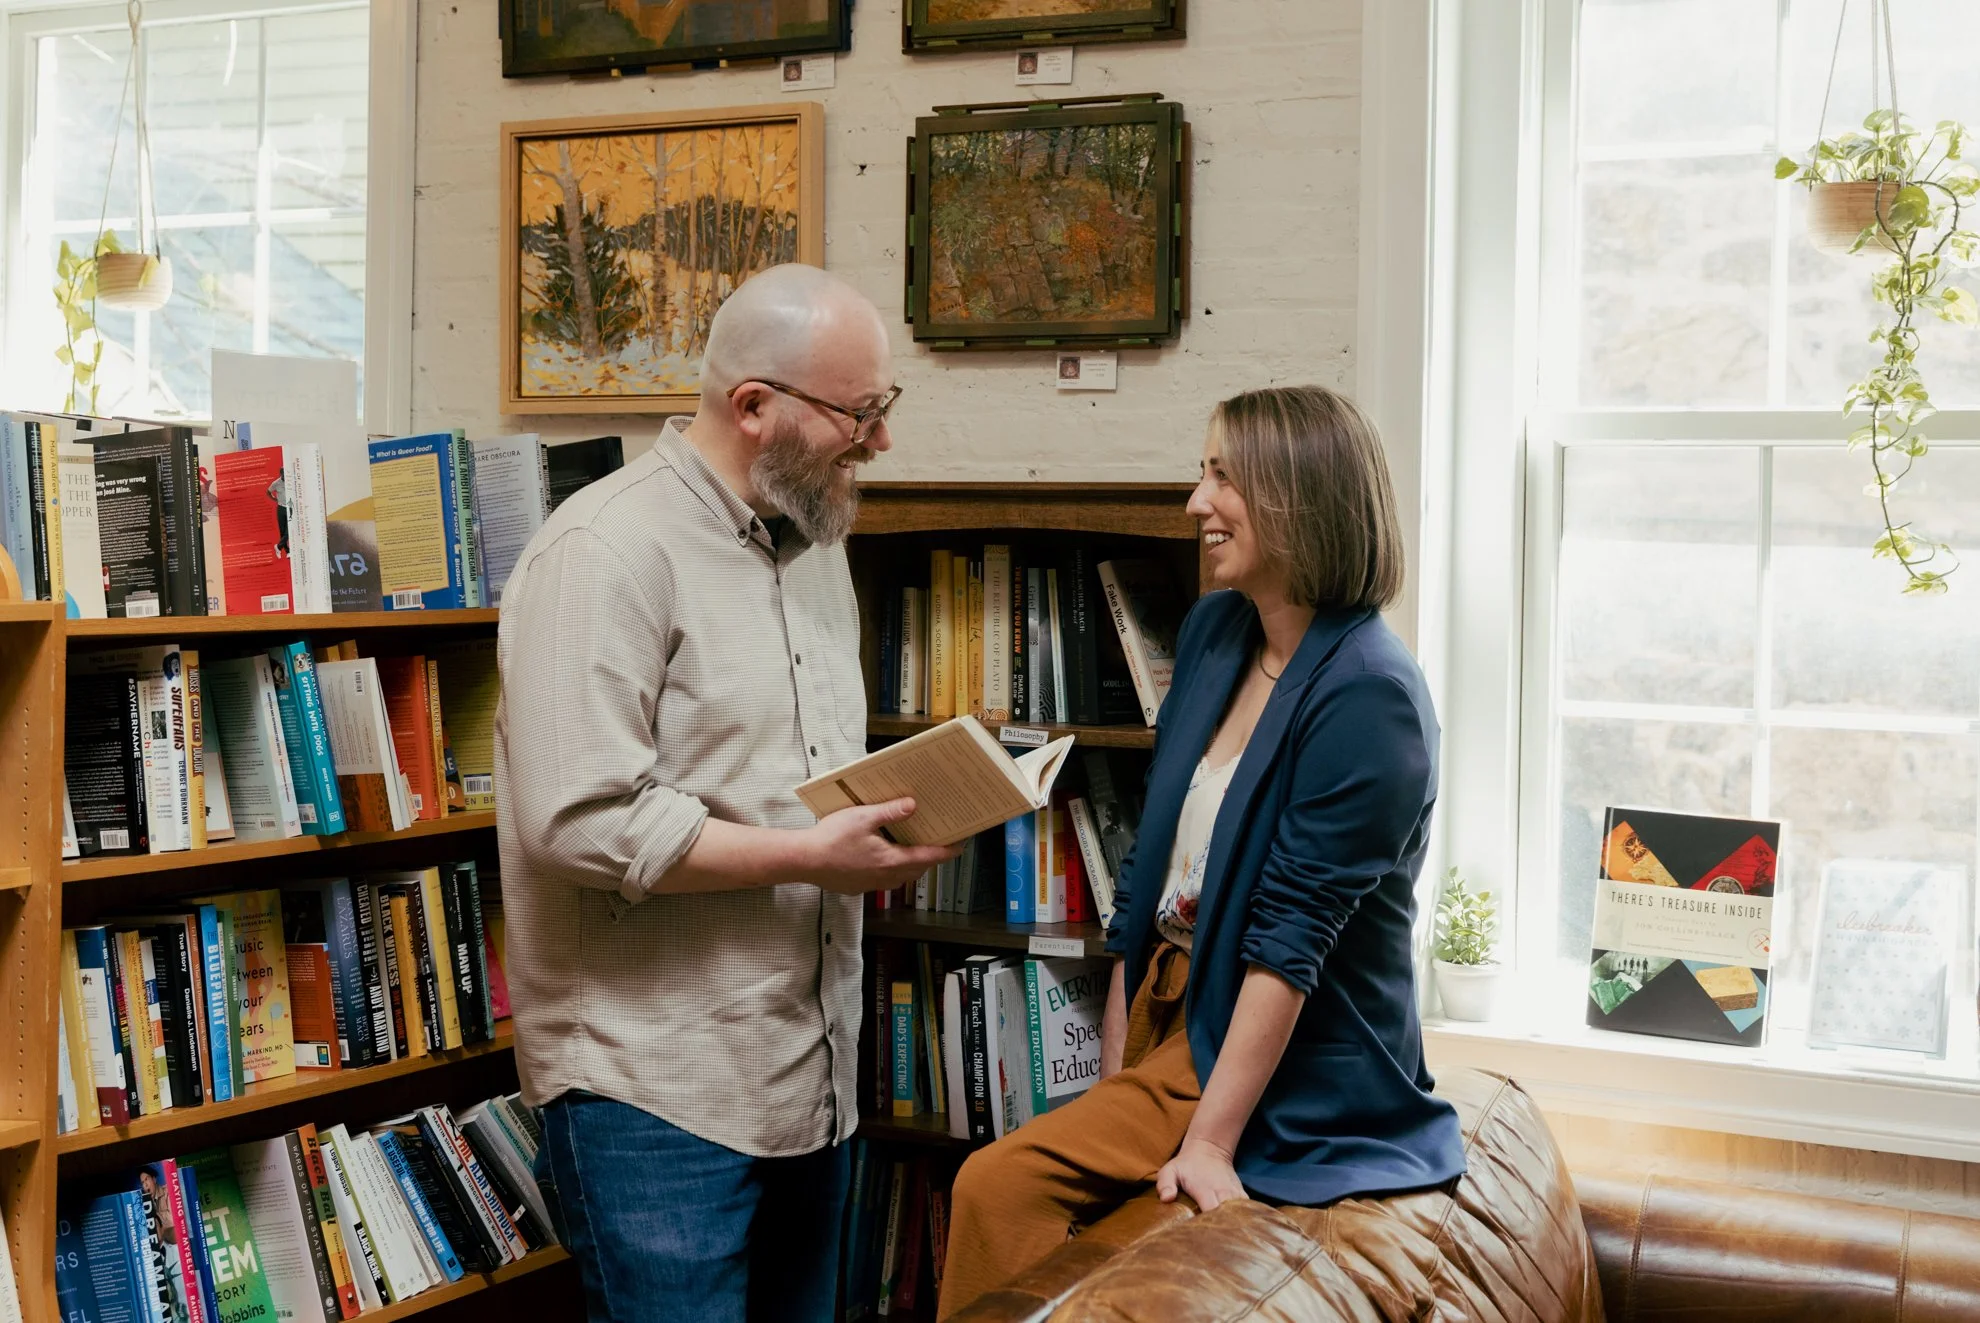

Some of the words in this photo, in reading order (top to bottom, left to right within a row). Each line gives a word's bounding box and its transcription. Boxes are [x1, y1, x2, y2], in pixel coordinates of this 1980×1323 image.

[415, 444, 433, 452] Food?
[458, 437, 466, 466] MORAL
[66, 474, 90, 485] THE
[129, 476, 146, 484] wrong
[297, 473, 301, 481] OF
[460, 468, 471, 510] AMBITION
[68, 491, 91, 501] THE
[104, 487, 115, 496] José
[465, 518, 475, 545] RUTGER
[467, 547, 477, 582] BREGMAN
[993, 569, 1001, 588] THE
[1028, 585, 1036, 611] Grief
[1105, 583, 1118, 607] Fake
[1114, 608, 1128, 635] Work
[993, 592, 1001, 640] REPUBLIC
[993, 642, 1001, 657] OF
[189, 668, 199, 693] MOSES
[301, 676, 312, 708] SITTING
[936, 687, 942, 697] US
[127, 678, 140, 758] #SAYHERNAME
[171, 687, 184, 751] SUPERFANS
[308, 710, 319, 732] WITH
[431, 694, 440, 737] WELLNESS
[313, 735, 324, 756] DOGS
[1004, 728, 1045, 742] Philosophy
[178, 761, 186, 786] GEORGE
[193, 747, 202, 773] DOCTOR
[179, 788, 188, 825] DOHRMANN
[1076, 816, 1089, 849] DIALOGUES
[1084, 849, 1091, 857] OF
[1068, 875, 1076, 897] PLATO
[1086, 859, 1099, 887] SOCRATES
[357, 884, 372, 924] CHEATED
[1096, 890, 1104, 906] PLATO
[1610, 891, 1654, 907] THERE'S
[1661, 897, 1717, 914] TREASURE
[1724, 903, 1763, 919] INSIDE
[346, 897, 359, 953] RAISING
[379, 895, 392, 934] BLACK
[455, 897, 463, 930] Miller-Idriss
[337, 897, 352, 959] LAZARUS
[1635, 922, 1652, 930] JON
[1657, 924, 1737, 939] COLLINS-BLACK
[457, 943, 470, 974] MAN
[1034, 941, 1075, 952] Parenting
[237, 965, 273, 982] tween
[385, 936, 399, 987] WITNESS
[207, 945, 225, 1025] BLUEPRINT
[370, 985, 383, 1009] ANDY
[392, 990, 400, 1005] AMY
[426, 978, 435, 1002] Latif
[461, 975, 472, 994] UP
[116, 984, 126, 1015] LESSONS
[180, 952, 188, 972] Story
[184, 988, 192, 1018] Danielle
[188, 1029, 197, 1071] Lindemann
[238, 994, 263, 1012] your
[971, 998, 982, 1028] Teach
[1027, 982, 1036, 1027] SPECIAL
[120, 1017, 127, 1025] IN
[240, 1022, 264, 1037] ears
[356, 1017, 364, 1042] MACY
[373, 1011, 389, 1053] MARTINO
[430, 1004, 441, 1047] Mercado
[897, 1016, 907, 1042] DAD'S
[121, 1028, 130, 1046] DRAG
[1064, 1022, 1102, 1051] Spec
[897, 1043, 907, 1089] EXPECTING
[973, 1052, 984, 1098] CHAMPION
[1031, 1030, 1043, 1094] EDUCATION
[975, 1100, 985, 1112] 3.0
[383, 1140, 392, 1150] BE
[432, 1115, 444, 1137] MARTIN
[443, 1138, 455, 1155] SHAW
[494, 1110, 528, 1162] Standardizing
[329, 1148, 342, 1172] Legacy
[337, 1173, 350, 1197] Russell
[374, 1154, 380, 1163] ME
[379, 1164, 385, 1173] ON
[384, 1173, 392, 1184] THE
[387, 1152, 404, 1177] USEFUL
[501, 1153, 522, 1185] Thoreau's
[521, 1185, 532, 1200] Axe
[306, 1136, 326, 1186] Black
[320, 1189, 337, 1225] Ball
[389, 1136, 405, 1163] ARNOLD
[406, 1165, 438, 1227] SCHWARZENEGGER
[401, 1178, 416, 1199] SEVEN
[455, 1134, 473, 1163] PHIL
[469, 1164, 488, 1191] ALAN
[485, 1191, 517, 1242] SHIPNUCK
[126, 1203, 136, 1225] MEN'S
[292, 1144, 305, 1177] WARDS
[301, 1183, 309, 1195] OF
[305, 1201, 314, 1221] THE
[310, 1224, 322, 1260] STATE
[413, 1200, 428, 1222] TOOLS
[464, 1174, 482, 1204] LITURGIES
[480, 1205, 486, 1213] OF
[484, 1214, 492, 1225] THE
[490, 1225, 501, 1240] WILD
[171, 1172, 184, 1217] PLAYING
[182, 1237, 194, 1276] MYSELF
[203, 1207, 230, 1245] ET
[424, 1223, 435, 1238] FOR
[130, 1227, 139, 1252] HEALTH
[433, 1238, 445, 1254] LIFE
[141, 1238, 156, 1285] BEGINNING
[357, 1227, 372, 1255] BLACK
[368, 1256, 382, 1281] MEME
[148, 1287, 161, 1312] AGAIN
[217, 1283, 247, 1302] EORY
